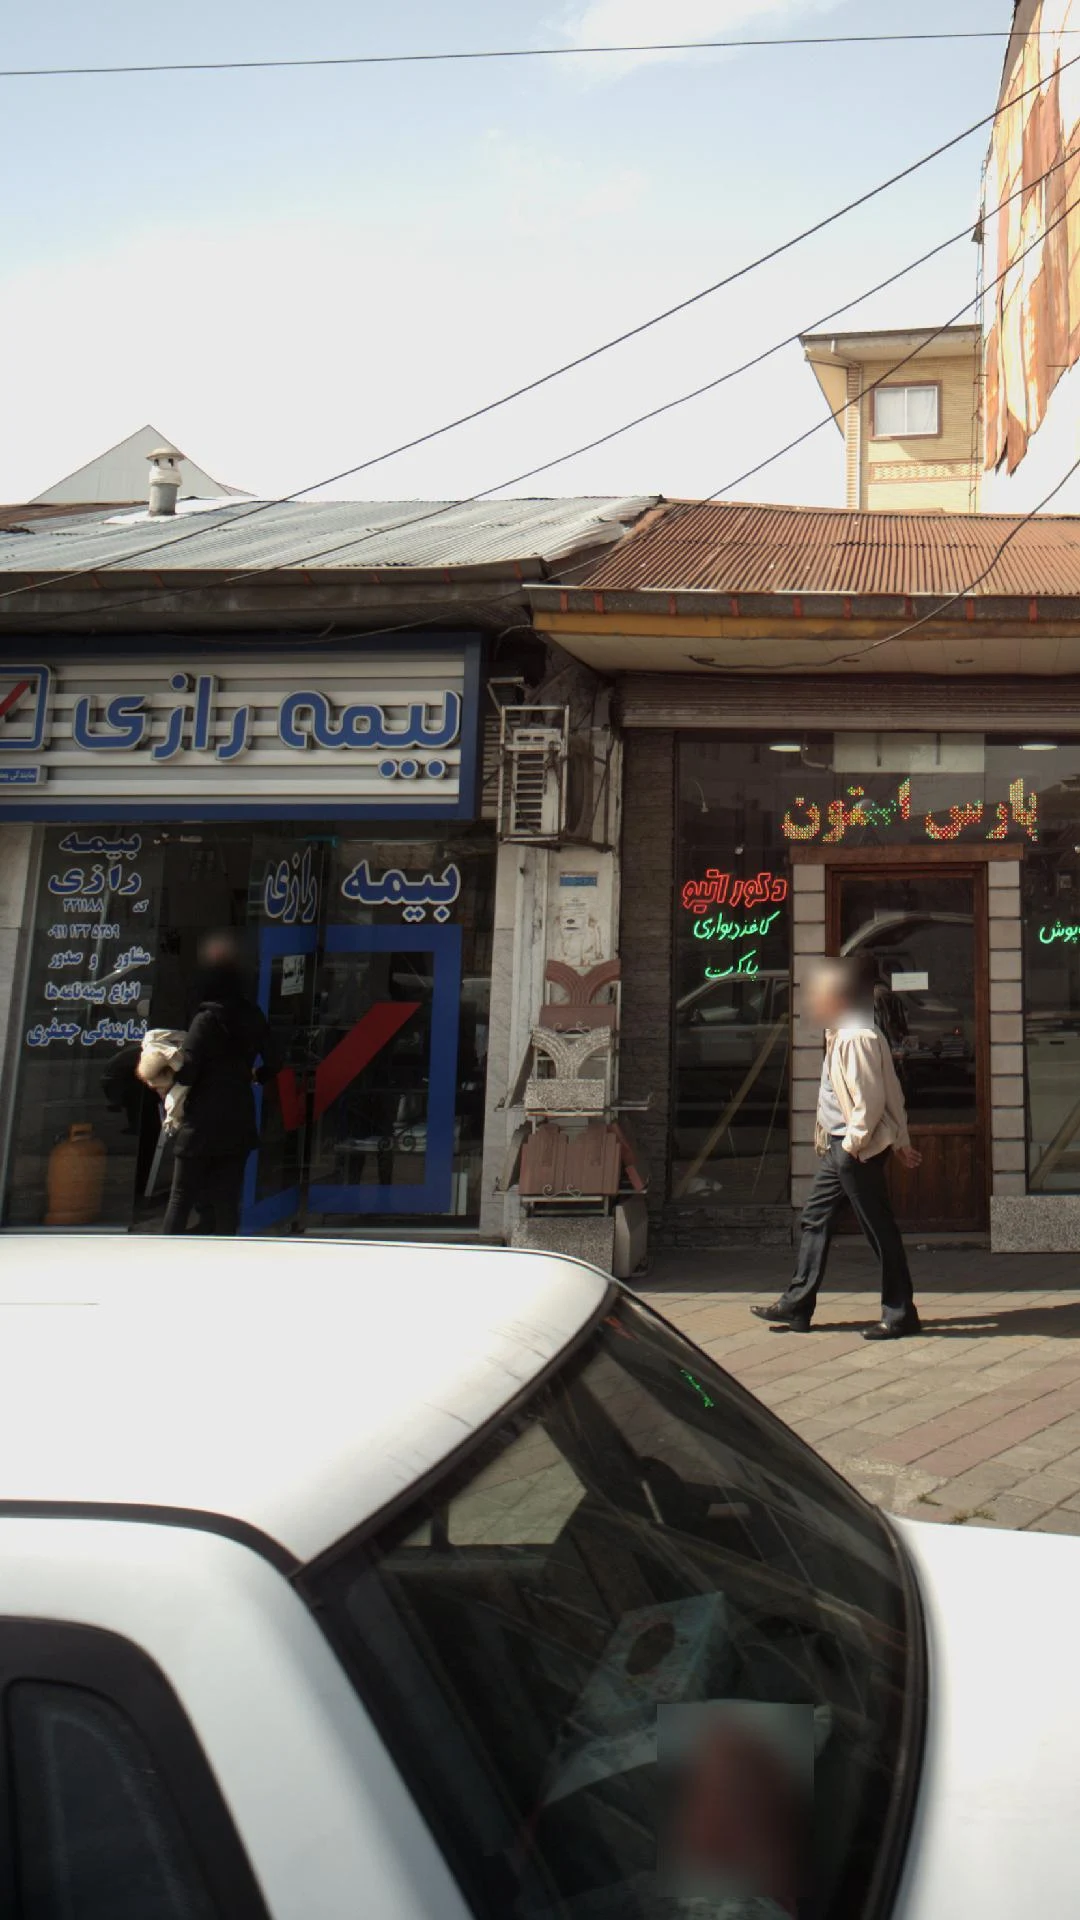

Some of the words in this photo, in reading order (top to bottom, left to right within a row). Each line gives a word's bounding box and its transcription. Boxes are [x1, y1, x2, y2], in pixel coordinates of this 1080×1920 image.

[73, 672, 251, 760] رازی
[278, 689, 463, 779] بیمه
[925, 777, 1038, 841] پارس
[58, 831, 142, 860] بیمه
[48, 863, 142, 894] رازی
[265, 845, 318, 923] رازی
[341, 859, 461, 923] بیمه
[132, 899, 150, 913] کد
[88, 953, 98, 970] و
[108, 981, 141, 1004] انواع
[27, 1017, 82, 1047] جعفری
